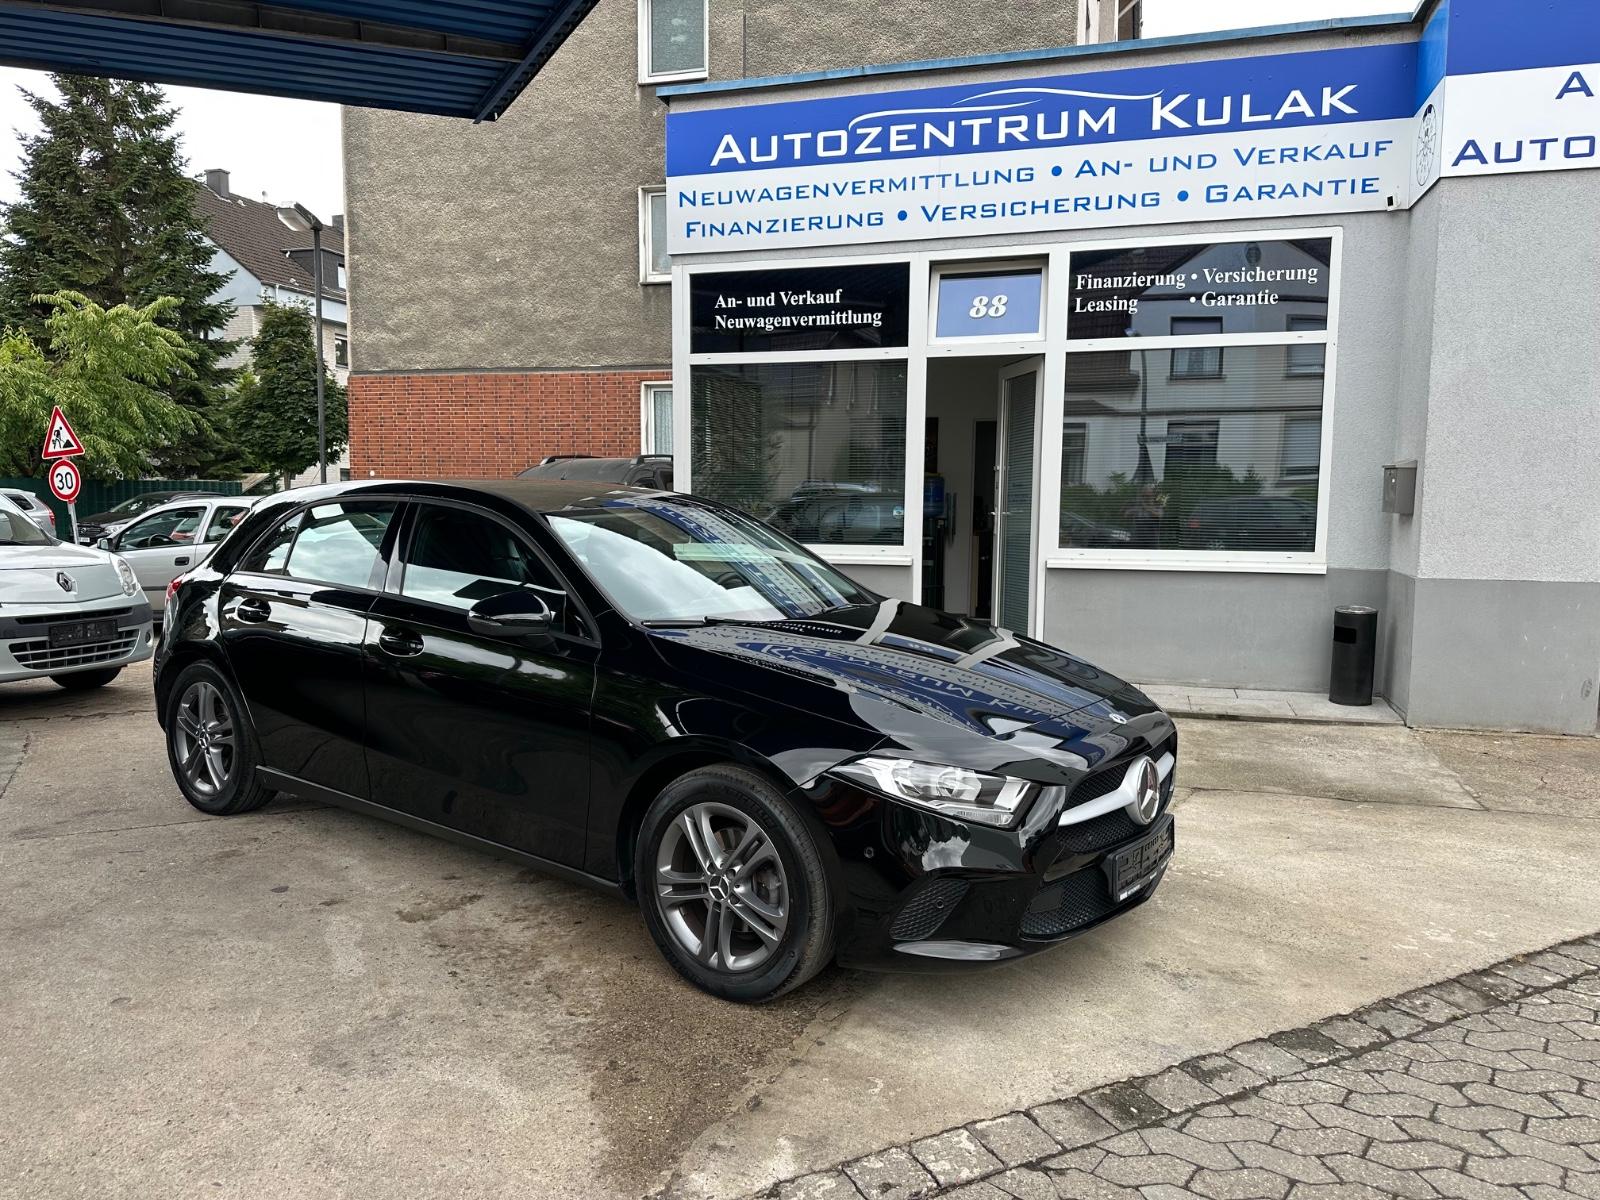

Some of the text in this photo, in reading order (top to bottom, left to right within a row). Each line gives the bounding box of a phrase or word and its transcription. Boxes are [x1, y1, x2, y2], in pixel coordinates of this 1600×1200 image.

[710, 84, 1360, 167] AUTOZENTRUM KULAK
[1451, 135, 1596, 167] AUTO
[678, 140, 1393, 208] NEUWAGENVERMITTLUNG AN- UND VERKAUF
[686, 177, 1380, 239] FINANZIERUNG VERSICHERUNG GARANTIE
[1076, 267, 1319, 290] Finanzierung Versicherung
[714, 289, 843, 309] An- und Verkauf
[969, 294, 1008, 319] 88
[1074, 289, 1279, 315] Leasing Garantie
[714, 310, 883, 332] Neuwagenvermittlung
[55, 471, 75, 491] 30
